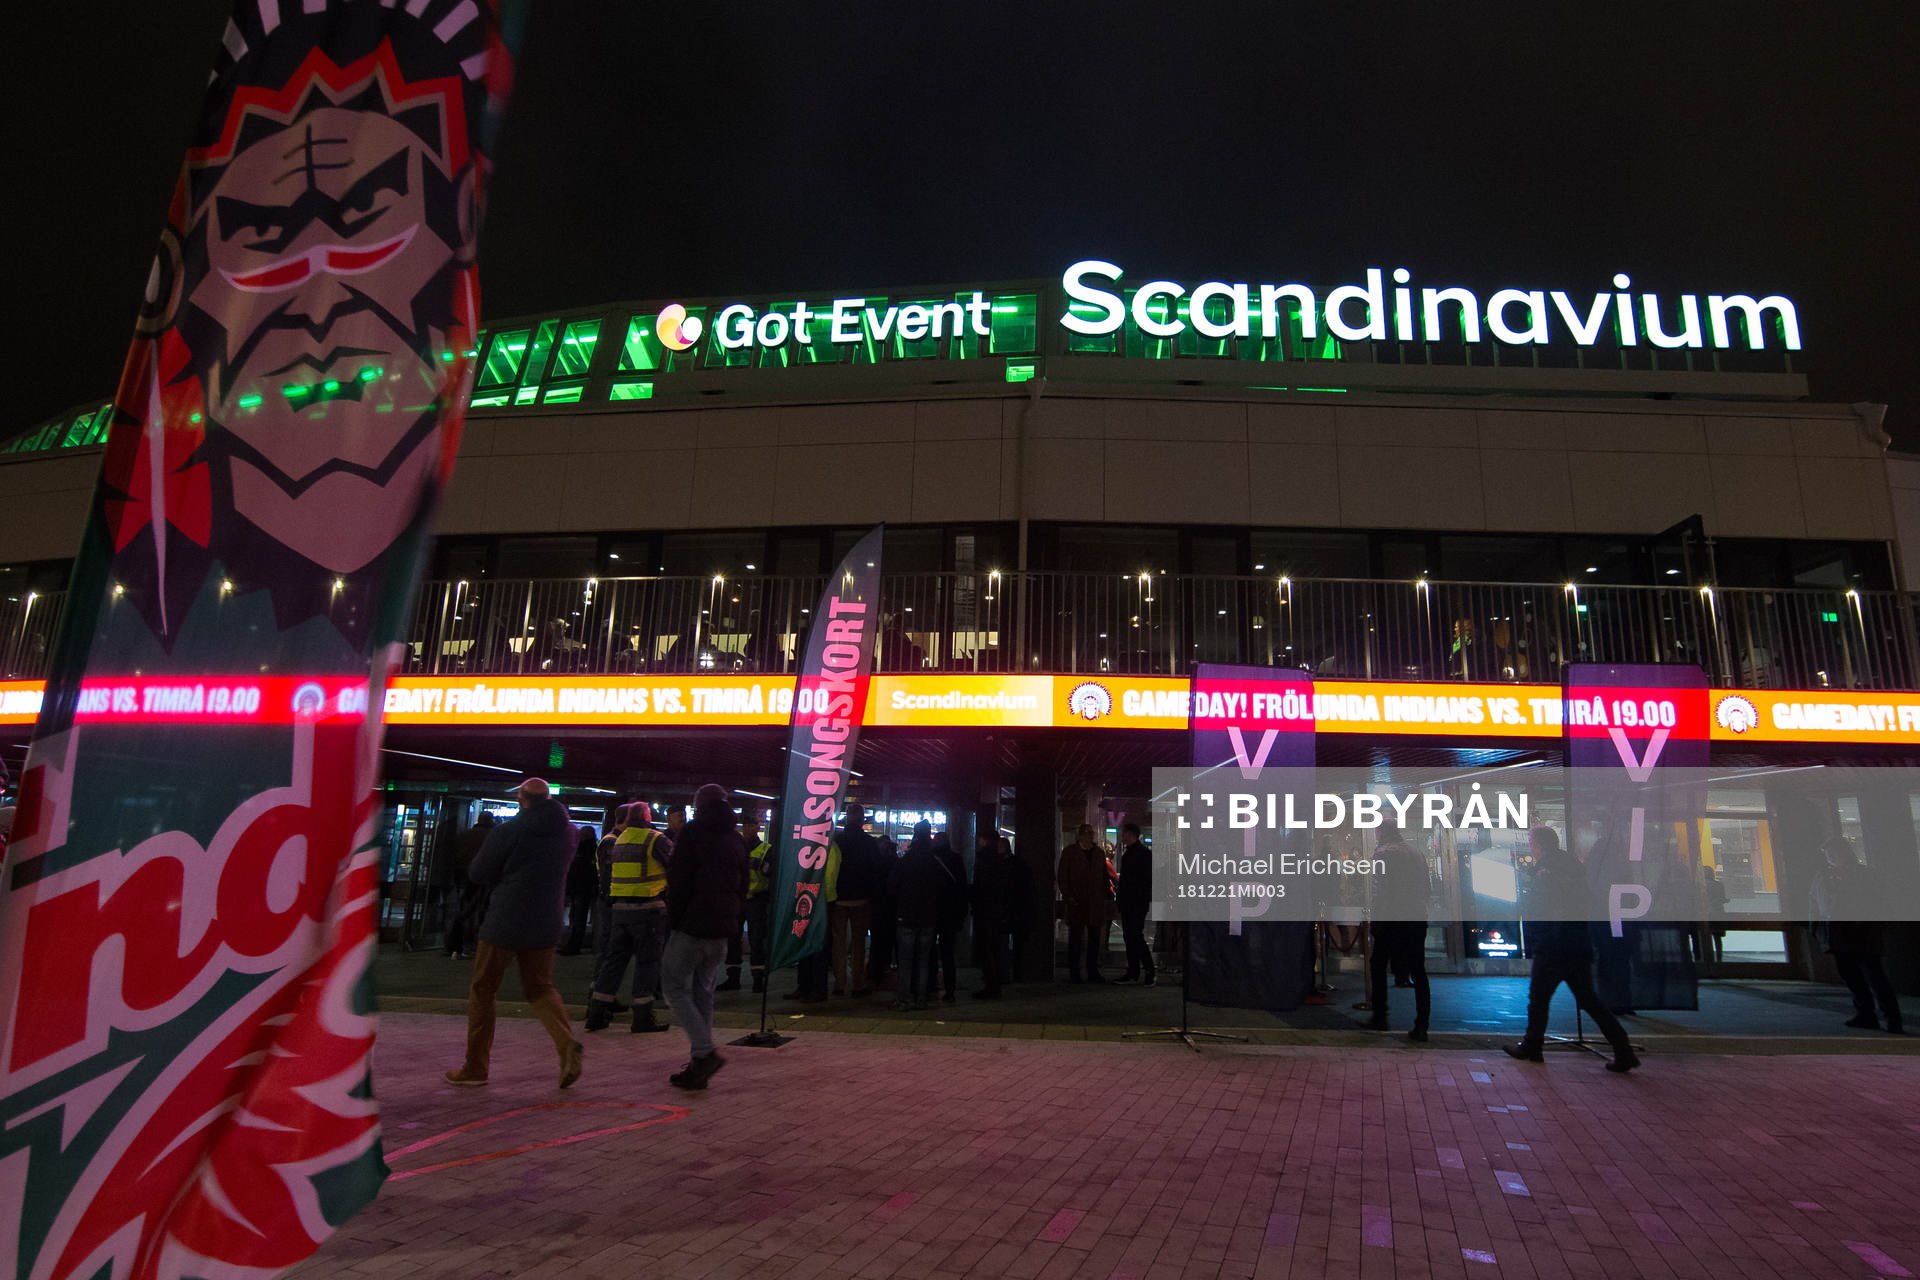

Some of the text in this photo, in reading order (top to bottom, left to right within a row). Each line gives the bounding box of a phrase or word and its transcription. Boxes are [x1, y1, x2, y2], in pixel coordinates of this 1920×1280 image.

[717, 292, 992, 349] Got Event
[1060, 260, 1802, 351] Scandinavium
[112, 687, 139, 712] VS.
[143, 683, 204, 713] TIMRÅ
[206, 687, 260, 713] 19.00
[444, 685, 554, 713] FRÖLUNDA
[559, 689, 648, 713] INDIANS
[653, 689, 686, 713] VS.
[691, 684, 764, 714] TIMRÅ
[891, 690, 1038, 710] Scandinavium
[1122, 689, 1676, 727] GAMEDAY! FRÖLUNDA INDIANS VS. TIMRÅ 19.00
[1772, 703, 1896, 731] GAMEDAY!
[793, 596, 867, 870] SÄSONGSKORT
[1608, 728, 1671, 937] VIP
